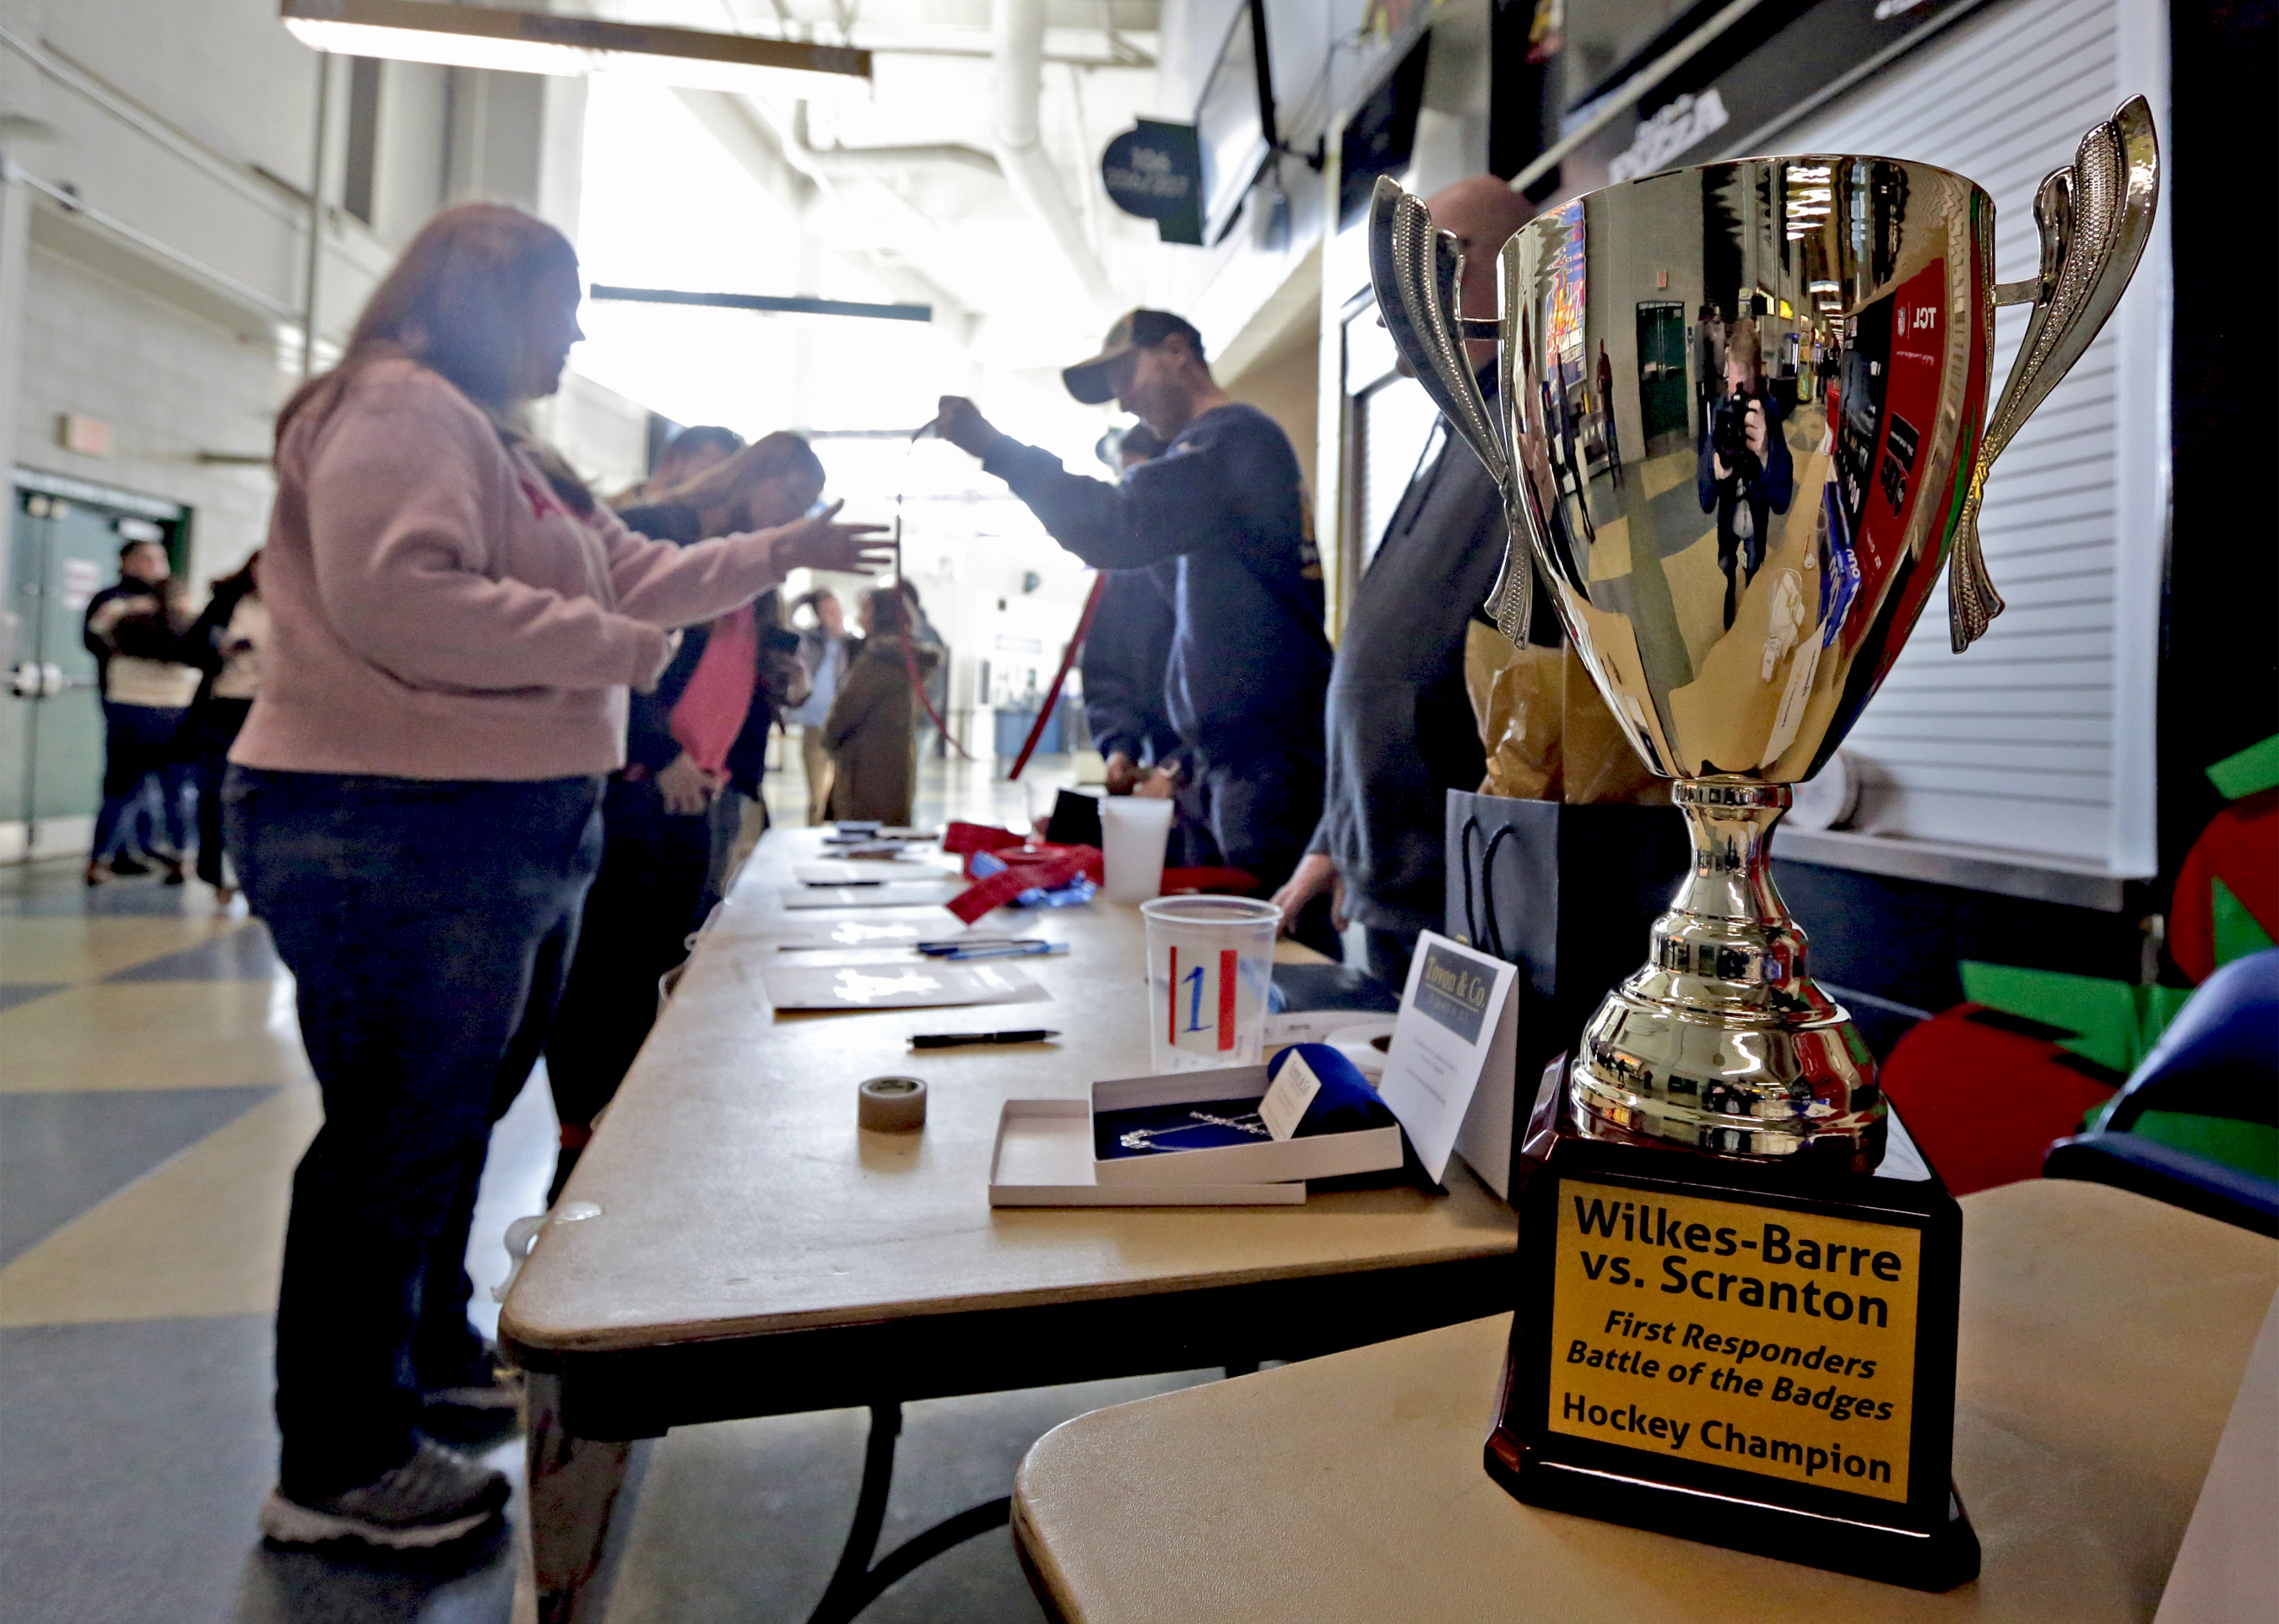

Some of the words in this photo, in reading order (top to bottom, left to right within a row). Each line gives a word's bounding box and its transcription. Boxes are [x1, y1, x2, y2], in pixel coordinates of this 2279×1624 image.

[1182, 966, 1213, 1033] 1
[1456, 971, 1470, 999] &
[1573, 1195, 1902, 1282] Wilkes-Barre
[1579, 1250, 1644, 1288] vs.
[1660, 1255, 1888, 1329] Scranton
[1566, 1340, 1660, 1378] Battle
[1667, 1361, 1707, 1386] of
[1709, 1368, 1763, 1398] the
[1771, 1376, 1894, 1421] Badges
[1604, 1309, 1676, 1345] First
[1681, 1323, 1878, 1379] Responders
[1563, 1392, 1691, 1450] Hockey
[1700, 1420, 1892, 1484] Champion
